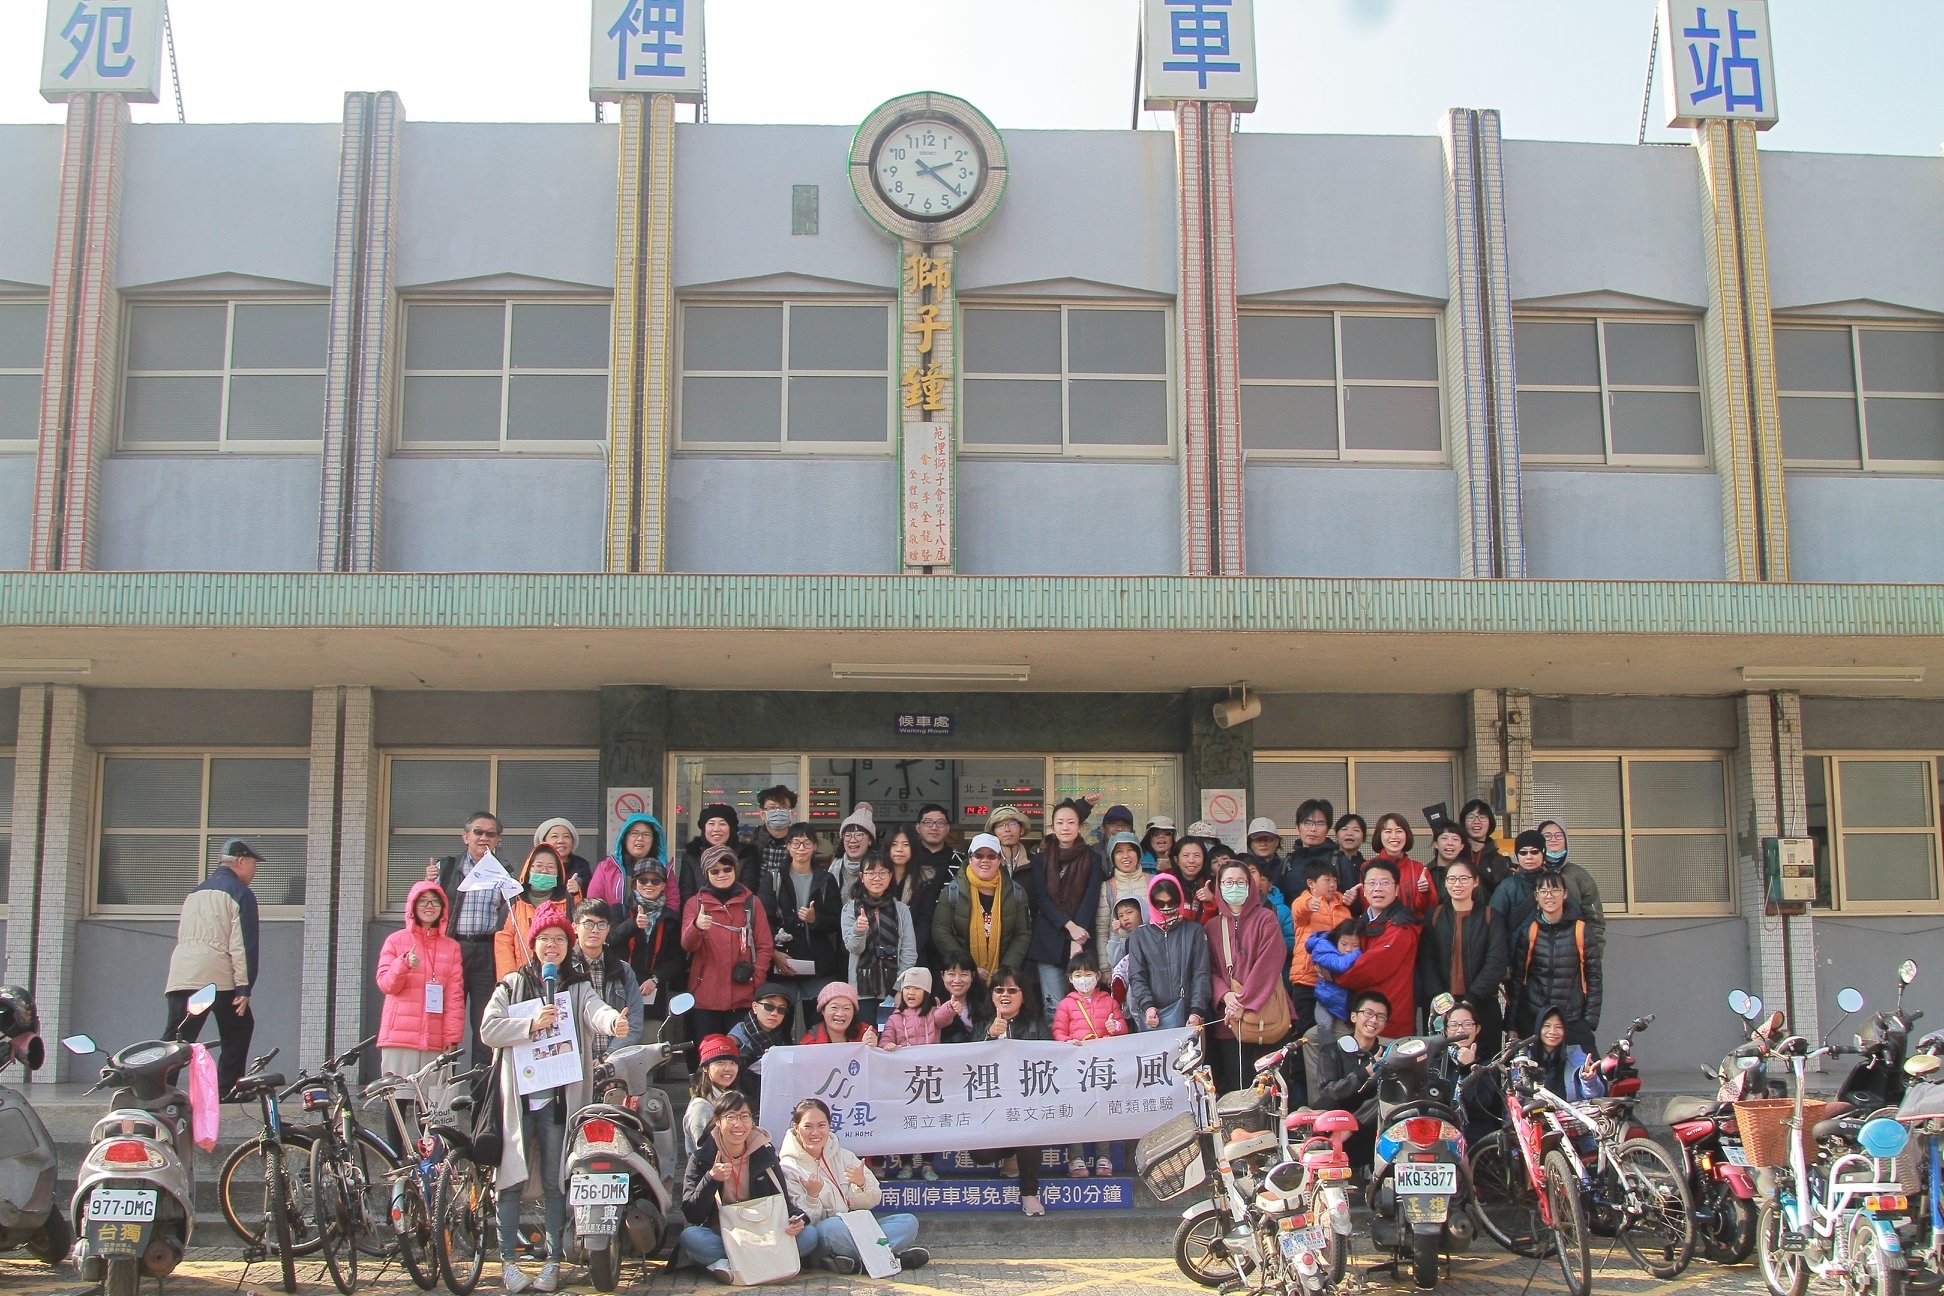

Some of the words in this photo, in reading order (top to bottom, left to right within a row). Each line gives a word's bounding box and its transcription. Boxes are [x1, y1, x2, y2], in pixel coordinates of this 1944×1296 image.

[1163, 0, 1240, 89] 車
[1683, 7, 1763, 112] 站
[909, 137, 919, 149] 11
[922, 134, 935, 147] 12
[942, 138, 947, 150] 1
[894, 148, 906, 160] 10
[954, 150, 963, 162] 2
[889, 165, 898, 177] 9
[959, 167, 967, 179] 3
[894, 181, 903, 193] 8
[907, 193, 915, 204] 7
[923, 198, 932, 209] 6
[941, 194, 949, 206] 5
[902, 253, 951, 411] 獅子鐘
[899, 715, 950, 728] 候車處
[964, 783, 988, 794] 北上
[904, 1050, 1174, 1106] 苑裡掀海風
[903, 1112, 971, 1130] 獨立書店
[1006, 1103, 1073, 1122] 藝文活動
[1397, 1171, 1454, 1187] MKQ-3877
[573, 1183, 627, 1200] 756-DMK
[882, 1184, 1122, 1208] 南側停車場免費停30分鐘
[91, 1199, 154, 1216] 977-DMG
[98, 1223, 142, 1243] 台獨
